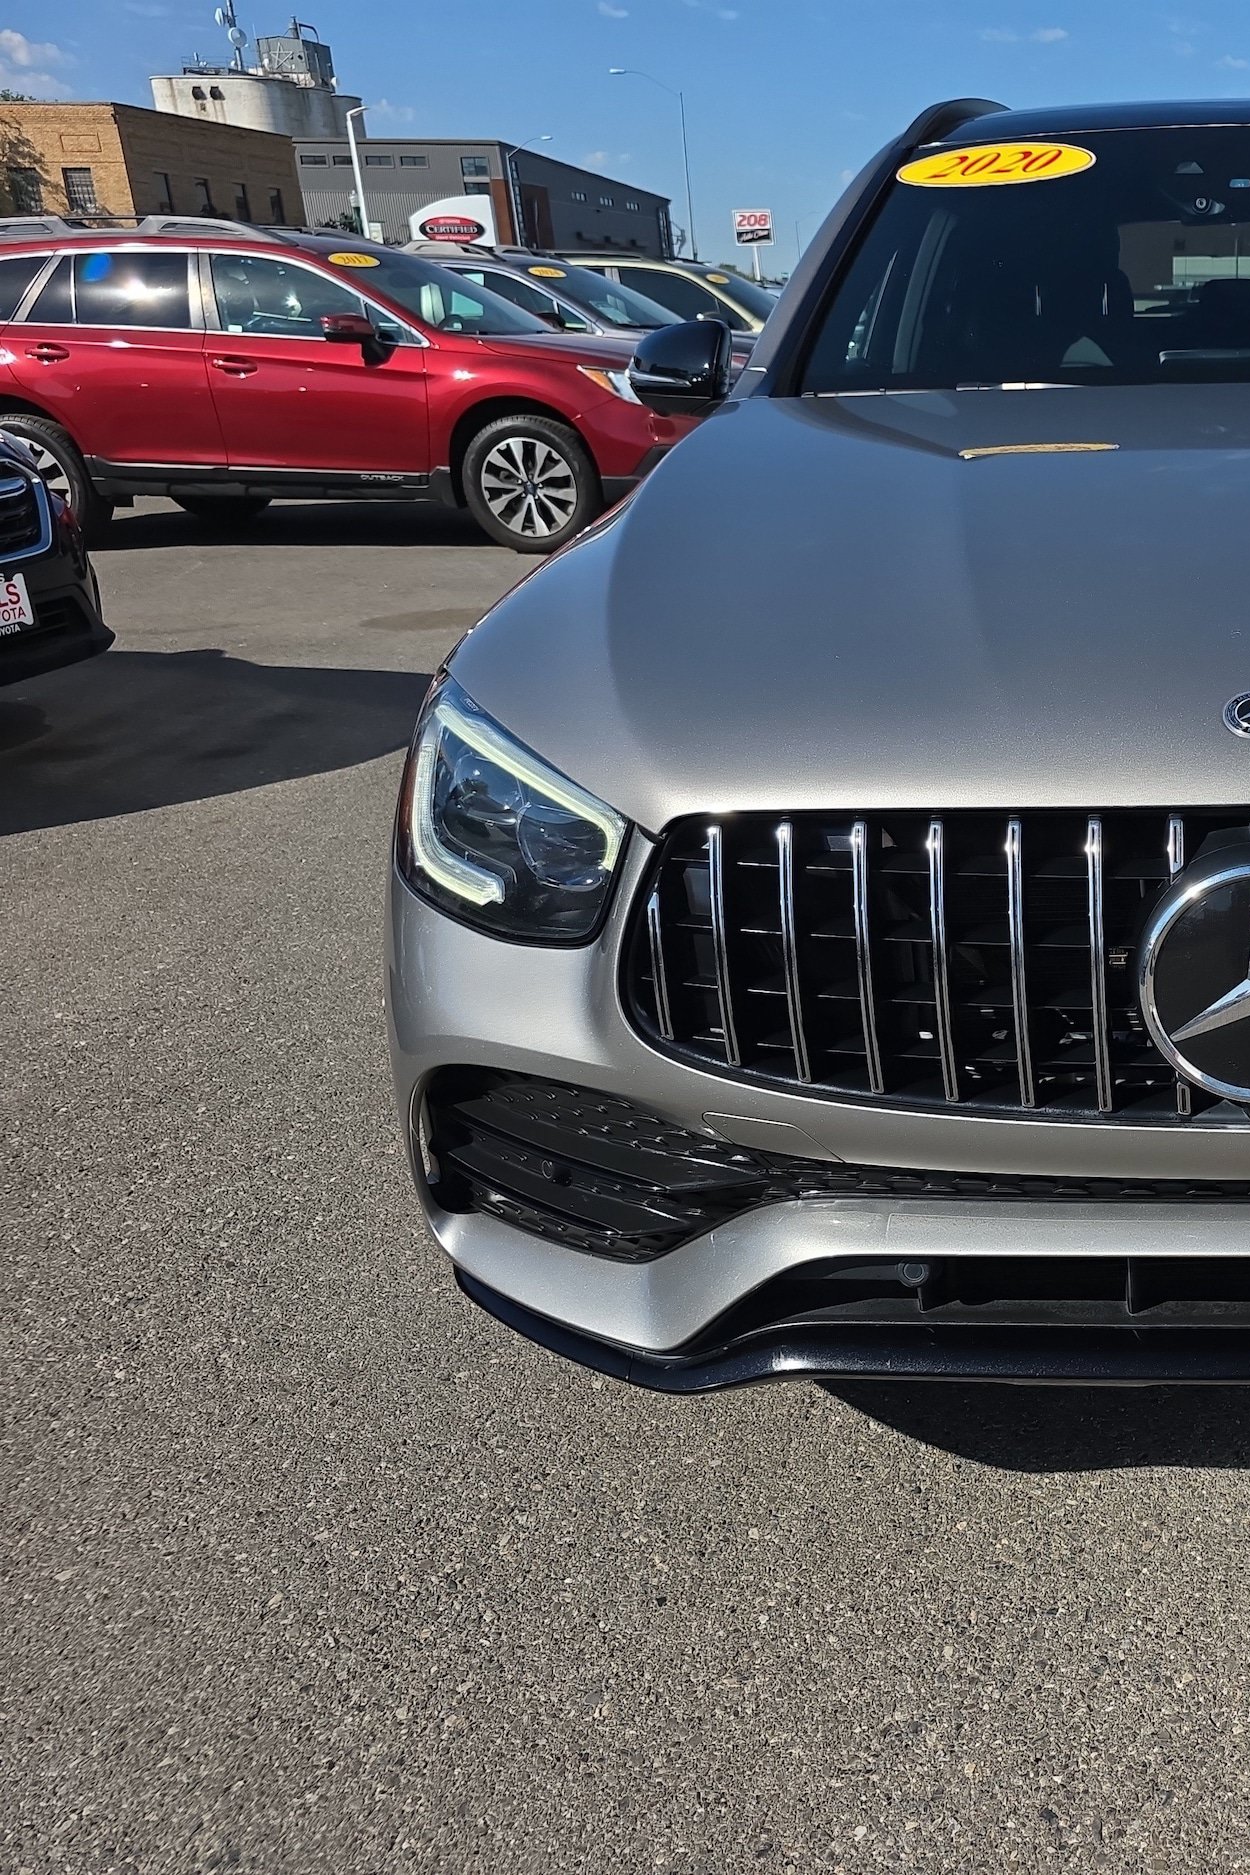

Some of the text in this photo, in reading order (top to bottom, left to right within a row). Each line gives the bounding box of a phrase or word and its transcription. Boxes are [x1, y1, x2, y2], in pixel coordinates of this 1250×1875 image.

[924, 149, 1063, 179] 2020
[737, 214, 769, 227] 208
[360, 473, 405, 482] OUTBACK
[0, 606, 26, 622] OTA
[0, 624, 21, 636] YOTA
